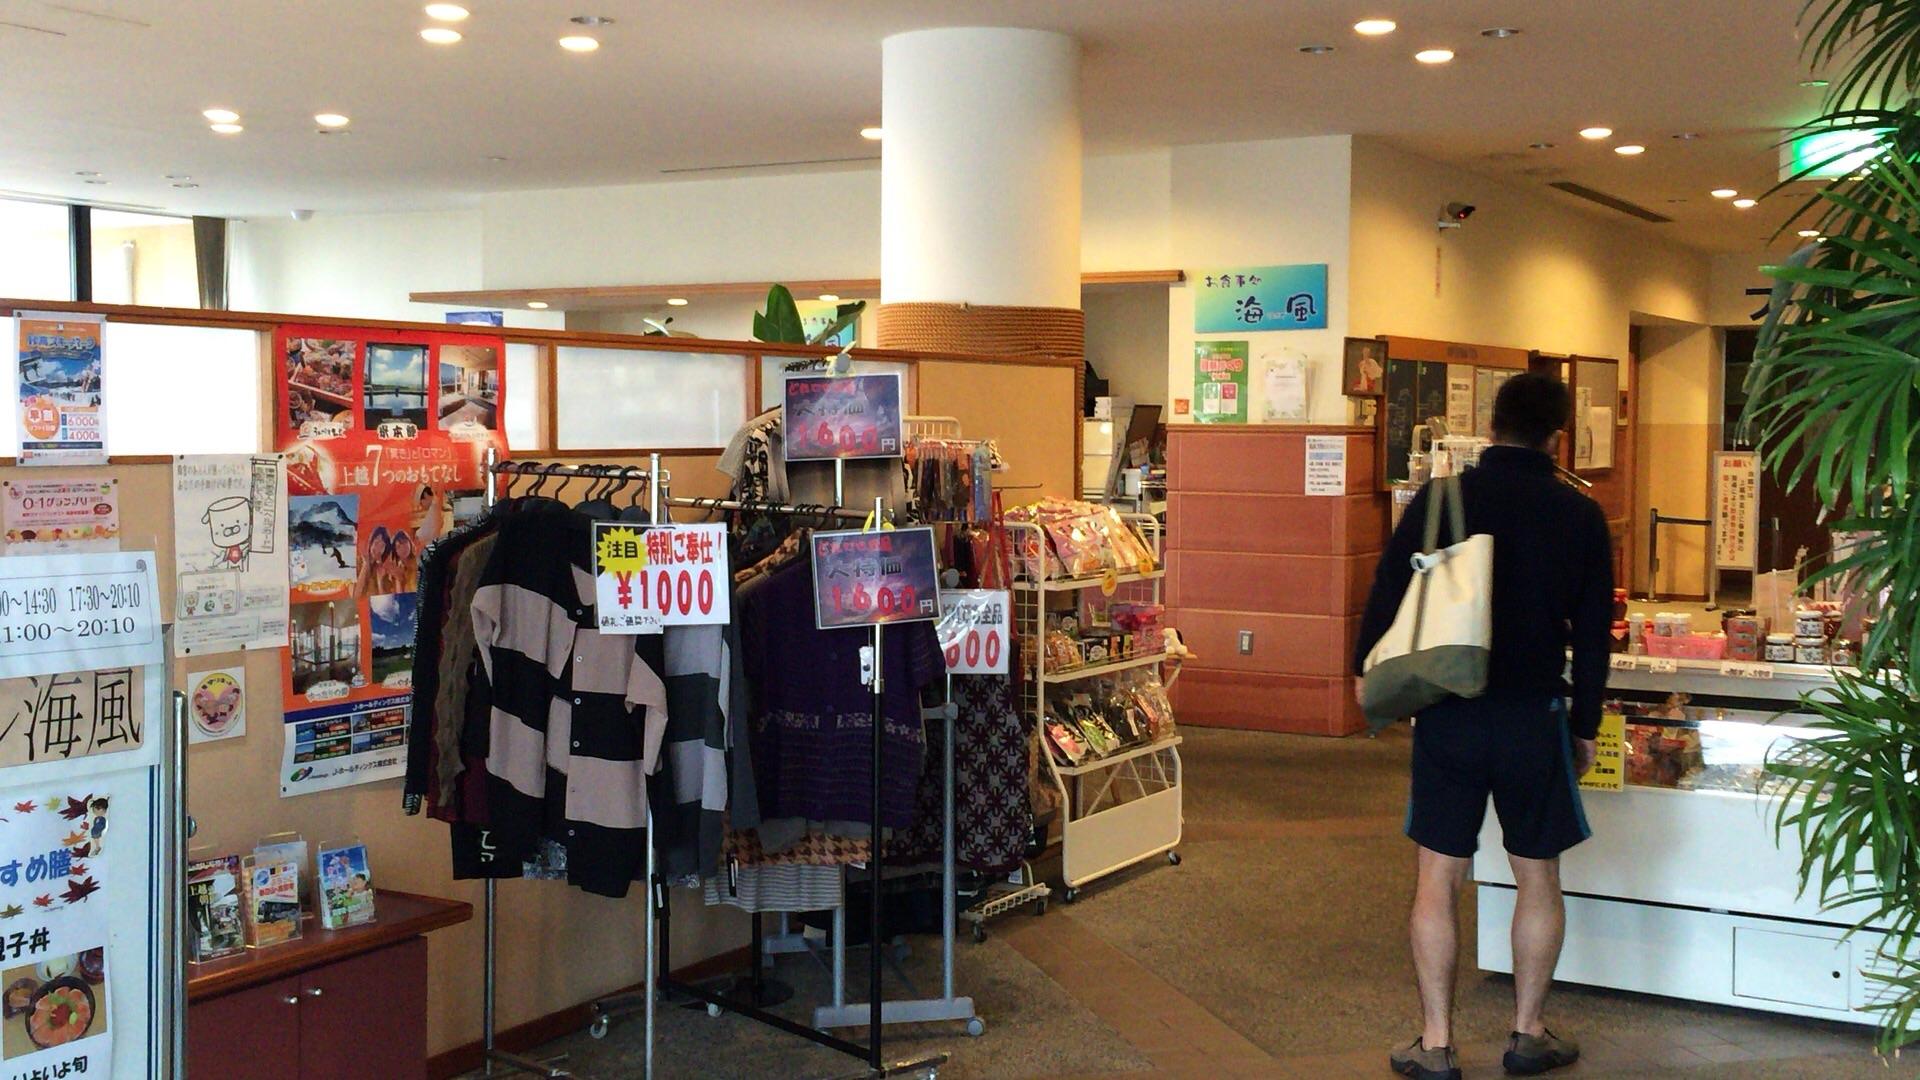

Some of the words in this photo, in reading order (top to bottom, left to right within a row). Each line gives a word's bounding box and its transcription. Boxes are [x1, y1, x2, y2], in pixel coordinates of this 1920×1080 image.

[1204, 274, 1263, 289] お食事処
[1234, 293, 1317, 324] 海風
[606, 540, 639, 559] 注目
[0, 587, 57, 617] 0～14:30
[616, 569, 714, 617] ¥1000
